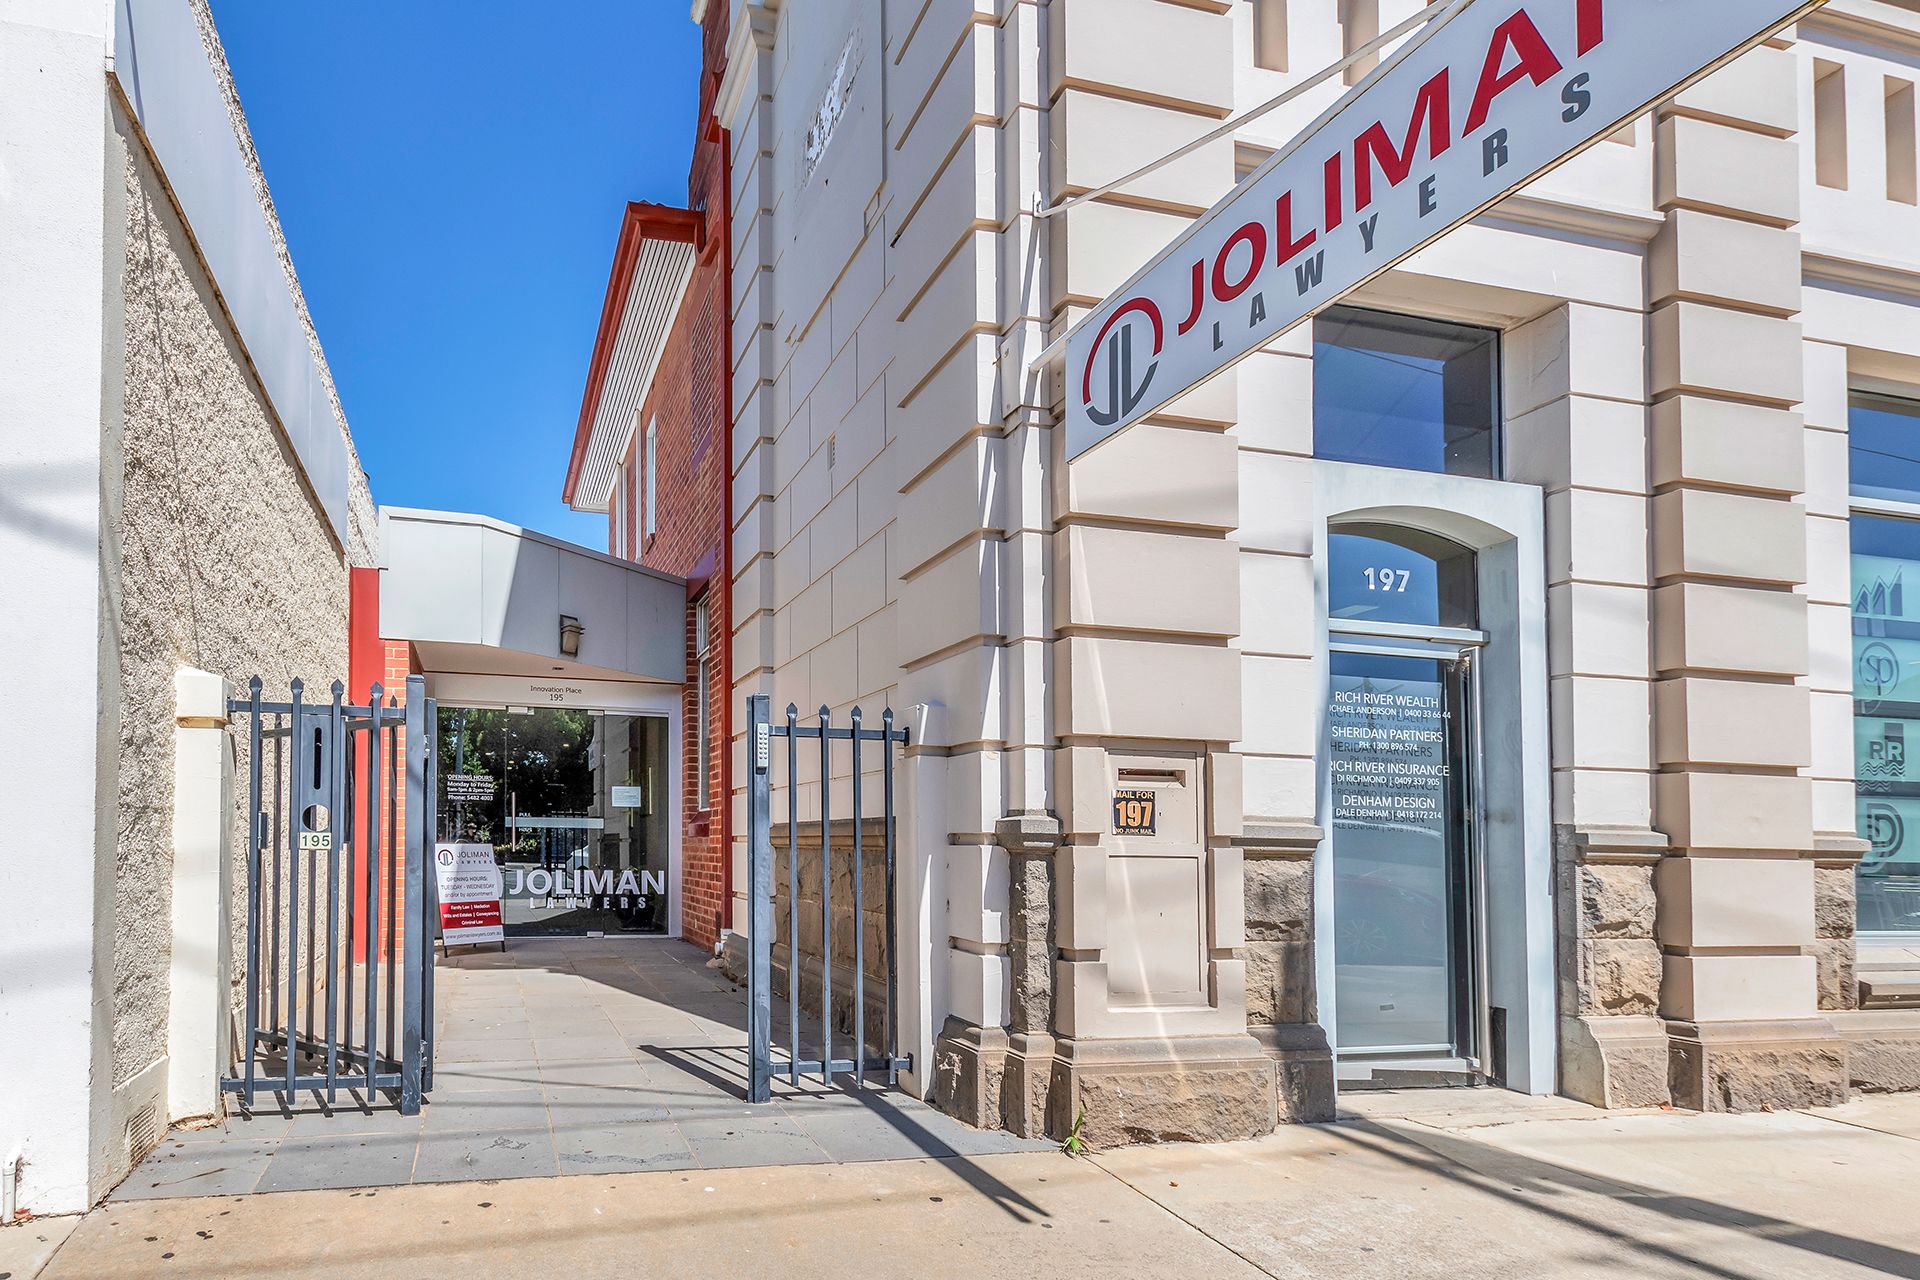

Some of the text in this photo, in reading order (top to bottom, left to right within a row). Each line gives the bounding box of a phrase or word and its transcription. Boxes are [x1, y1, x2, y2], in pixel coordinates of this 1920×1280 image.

[1213, 71, 1591, 352] LAWYERS
[1363, 567, 1410, 592] 197
[530, 685, 564, 693] Innovation
[1335, 691, 1439, 708] RICH RIVER WEALTH
[1356, 706, 1396, 716] ANDERSON
[1404, 709, 1421, 718] 0400
[1422, 710, 1431, 718] 33
[1432, 711, 1441, 719] 66
[1442, 711, 1451, 719] 44
[1331, 725, 1387, 739] SHERIDAN
[1389, 729, 1444, 743] PARTNERS
[1372, 741, 1390, 750] 1300
[1390, 742, 1404, 751] 896
[1405, 743, 1418, 751] 574
[1355, 761, 1385, 774] RIVER
[1387, 763, 1450, 776] INSURANCE
[1336, 774, 1345, 782] DI
[1346, 774, 1387, 784] RICHMOND
[1395, 776, 1412, 785] 0409
[1413, 777, 1426, 785] 337
[1427, 778, 1440, 786] 905
[1114, 790, 1154, 799] MAIL FOR
[1342, 794, 1435, 809] DENHAM DESIGN
[1115, 800, 1153, 827] 197
[1335, 808, 1355, 817] DALE
[1356, 808, 1389, 817] DENHAM
[1396, 810, 1414, 818] 0418
[1415, 810, 1428, 819] 172
[1429, 811, 1442, 819] 214
[301, 834, 330, 847] 195
[509, 869, 665, 895] JOLIMAN
[529, 896, 646, 909] LAWYERS
